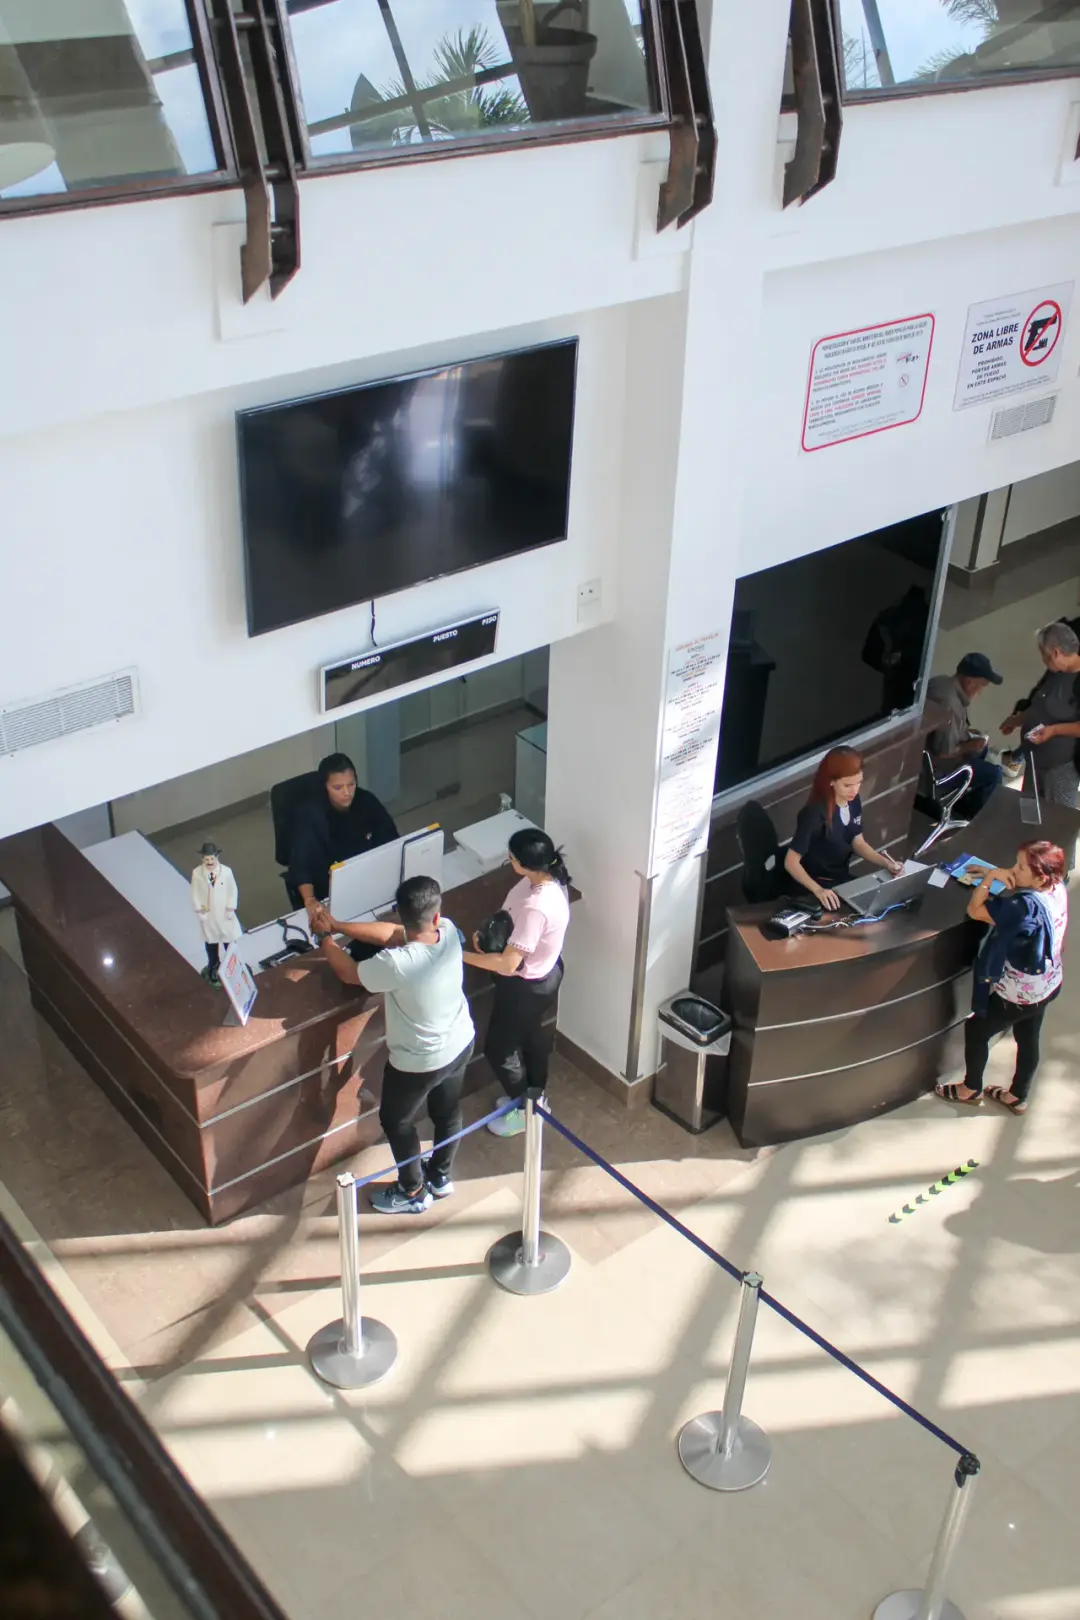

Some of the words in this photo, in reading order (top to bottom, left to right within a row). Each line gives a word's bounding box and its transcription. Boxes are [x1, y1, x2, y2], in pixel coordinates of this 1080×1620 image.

[971, 329, 994, 343] ZONA
[996, 323, 1019, 337] LIBRE
[973, 344, 984, 355] DE
[986, 336, 1013, 351] ARMAS
[482, 615, 497, 626] PISO
[433, 629, 458, 643] PUESTO
[351, 655, 381, 670] NUMERO
